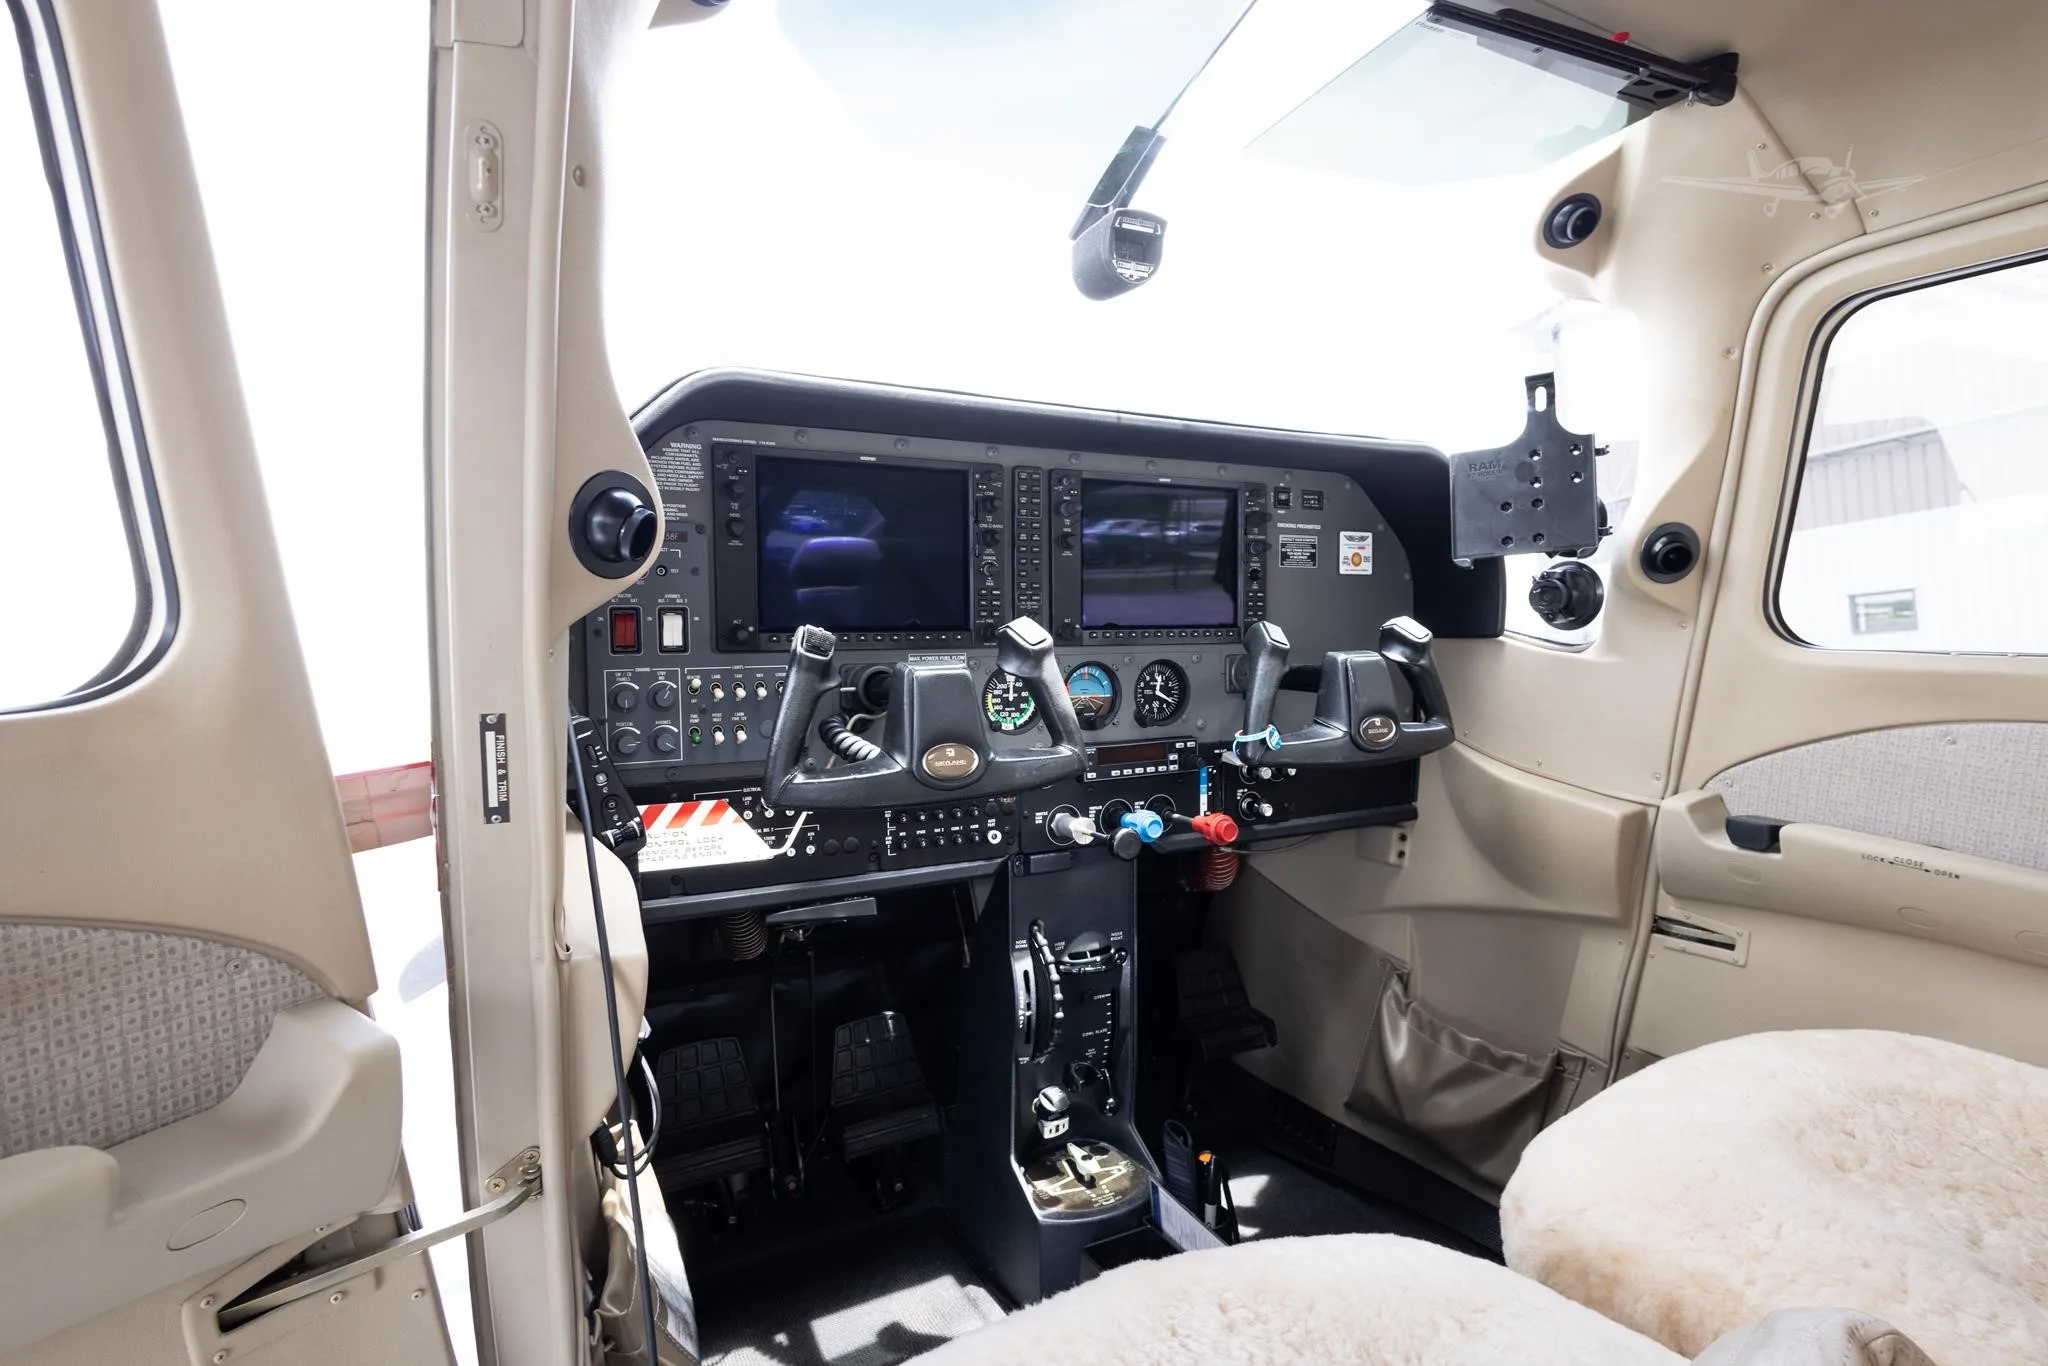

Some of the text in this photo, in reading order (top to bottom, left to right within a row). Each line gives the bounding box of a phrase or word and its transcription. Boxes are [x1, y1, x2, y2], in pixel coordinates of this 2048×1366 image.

[670, 441, 701, 450] WARNING
[1468, 460, 1503, 473] RAM
[495, 735, 506, 764] FINISH
[934, 759, 967, 767] SKYLANE
[498, 780, 508, 802] TRIM
[647, 830, 688, 840] AUTION
[646, 838, 690, 849] ONTROL
[1861, 853, 1885, 863] LOCK
[1894, 856, 1925, 867] CLOSE
[1934, 869, 1960, 879] OPEN
